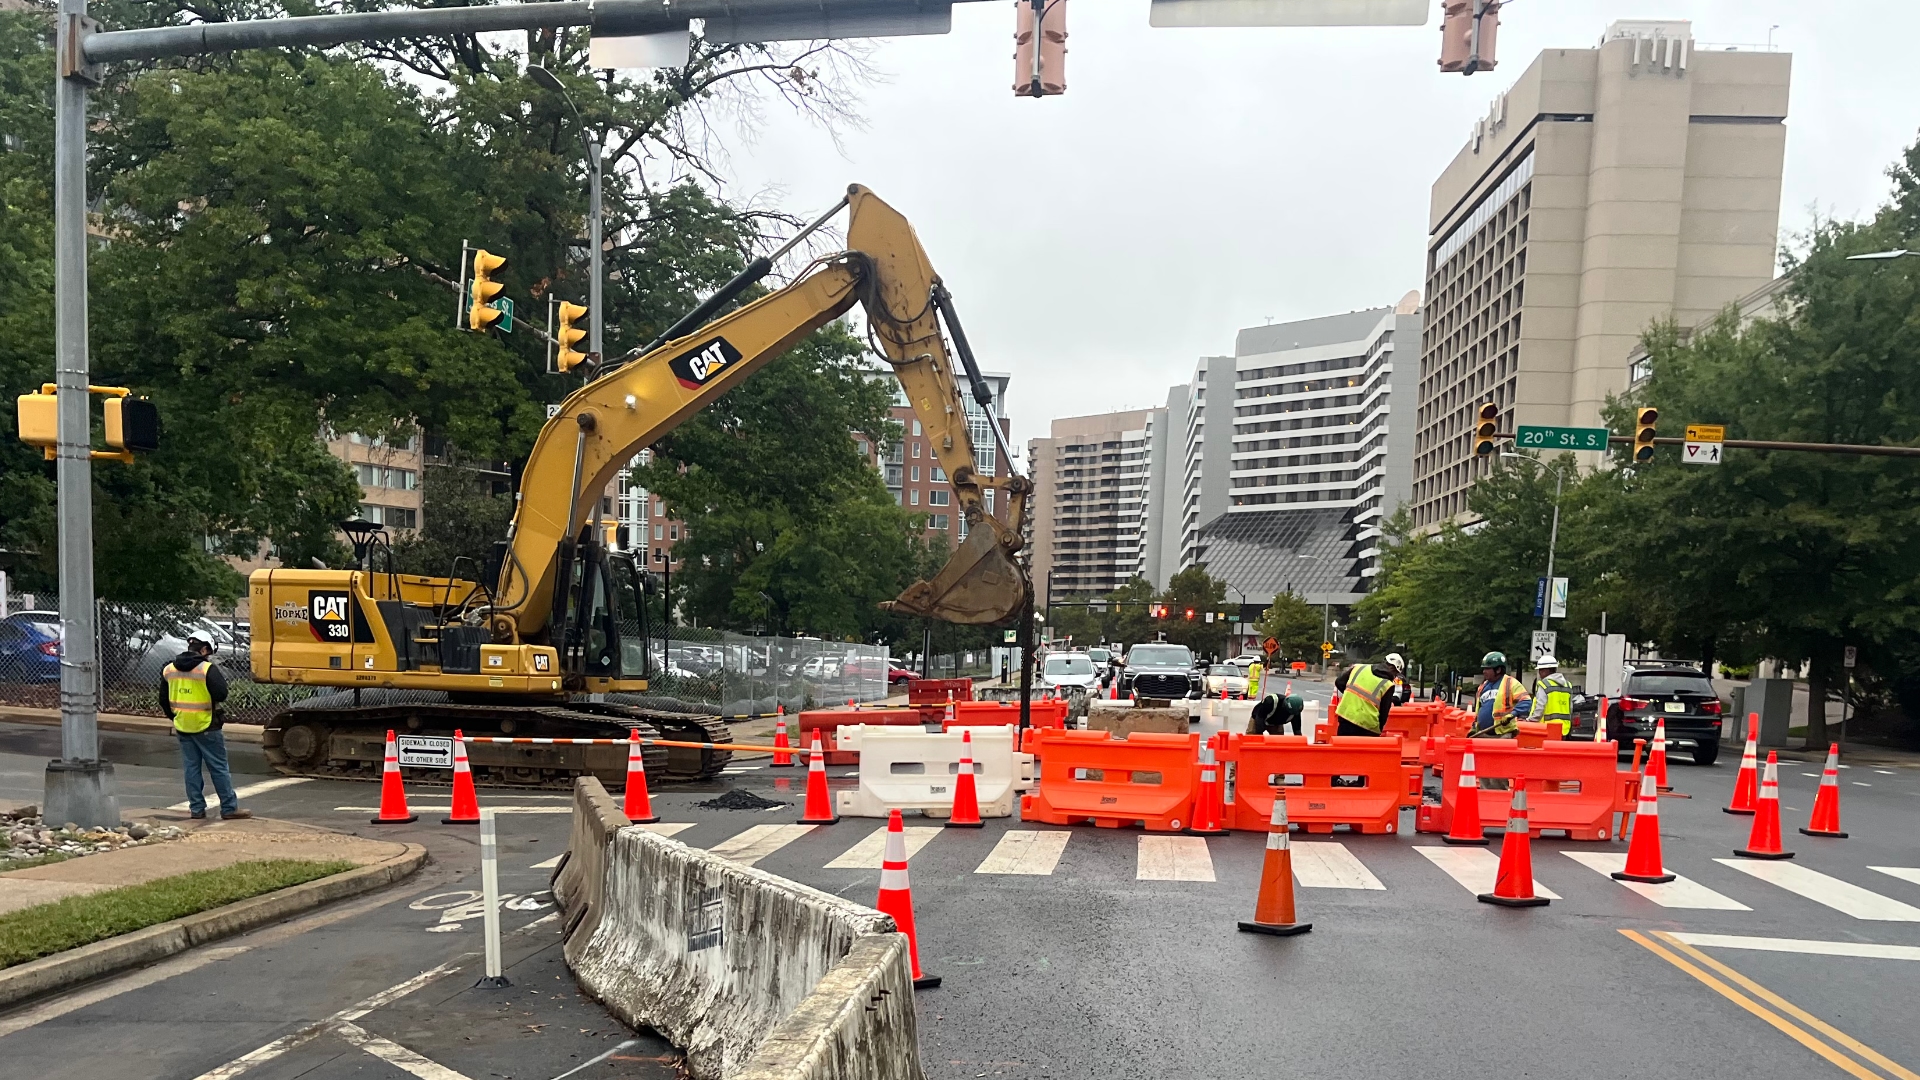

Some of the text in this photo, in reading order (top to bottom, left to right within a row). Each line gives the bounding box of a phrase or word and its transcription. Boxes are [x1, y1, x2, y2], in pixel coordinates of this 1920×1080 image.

[689, 341, 727, 380] CAT
[1524, 430, 1599, 446] 20th St. S.
[255, 587, 264, 595] 28
[275, 608, 307, 620] HOPKE
[313, 596, 347, 620] CAT
[328, 624, 348, 637] 330
[535, 655, 548, 670] CAT
